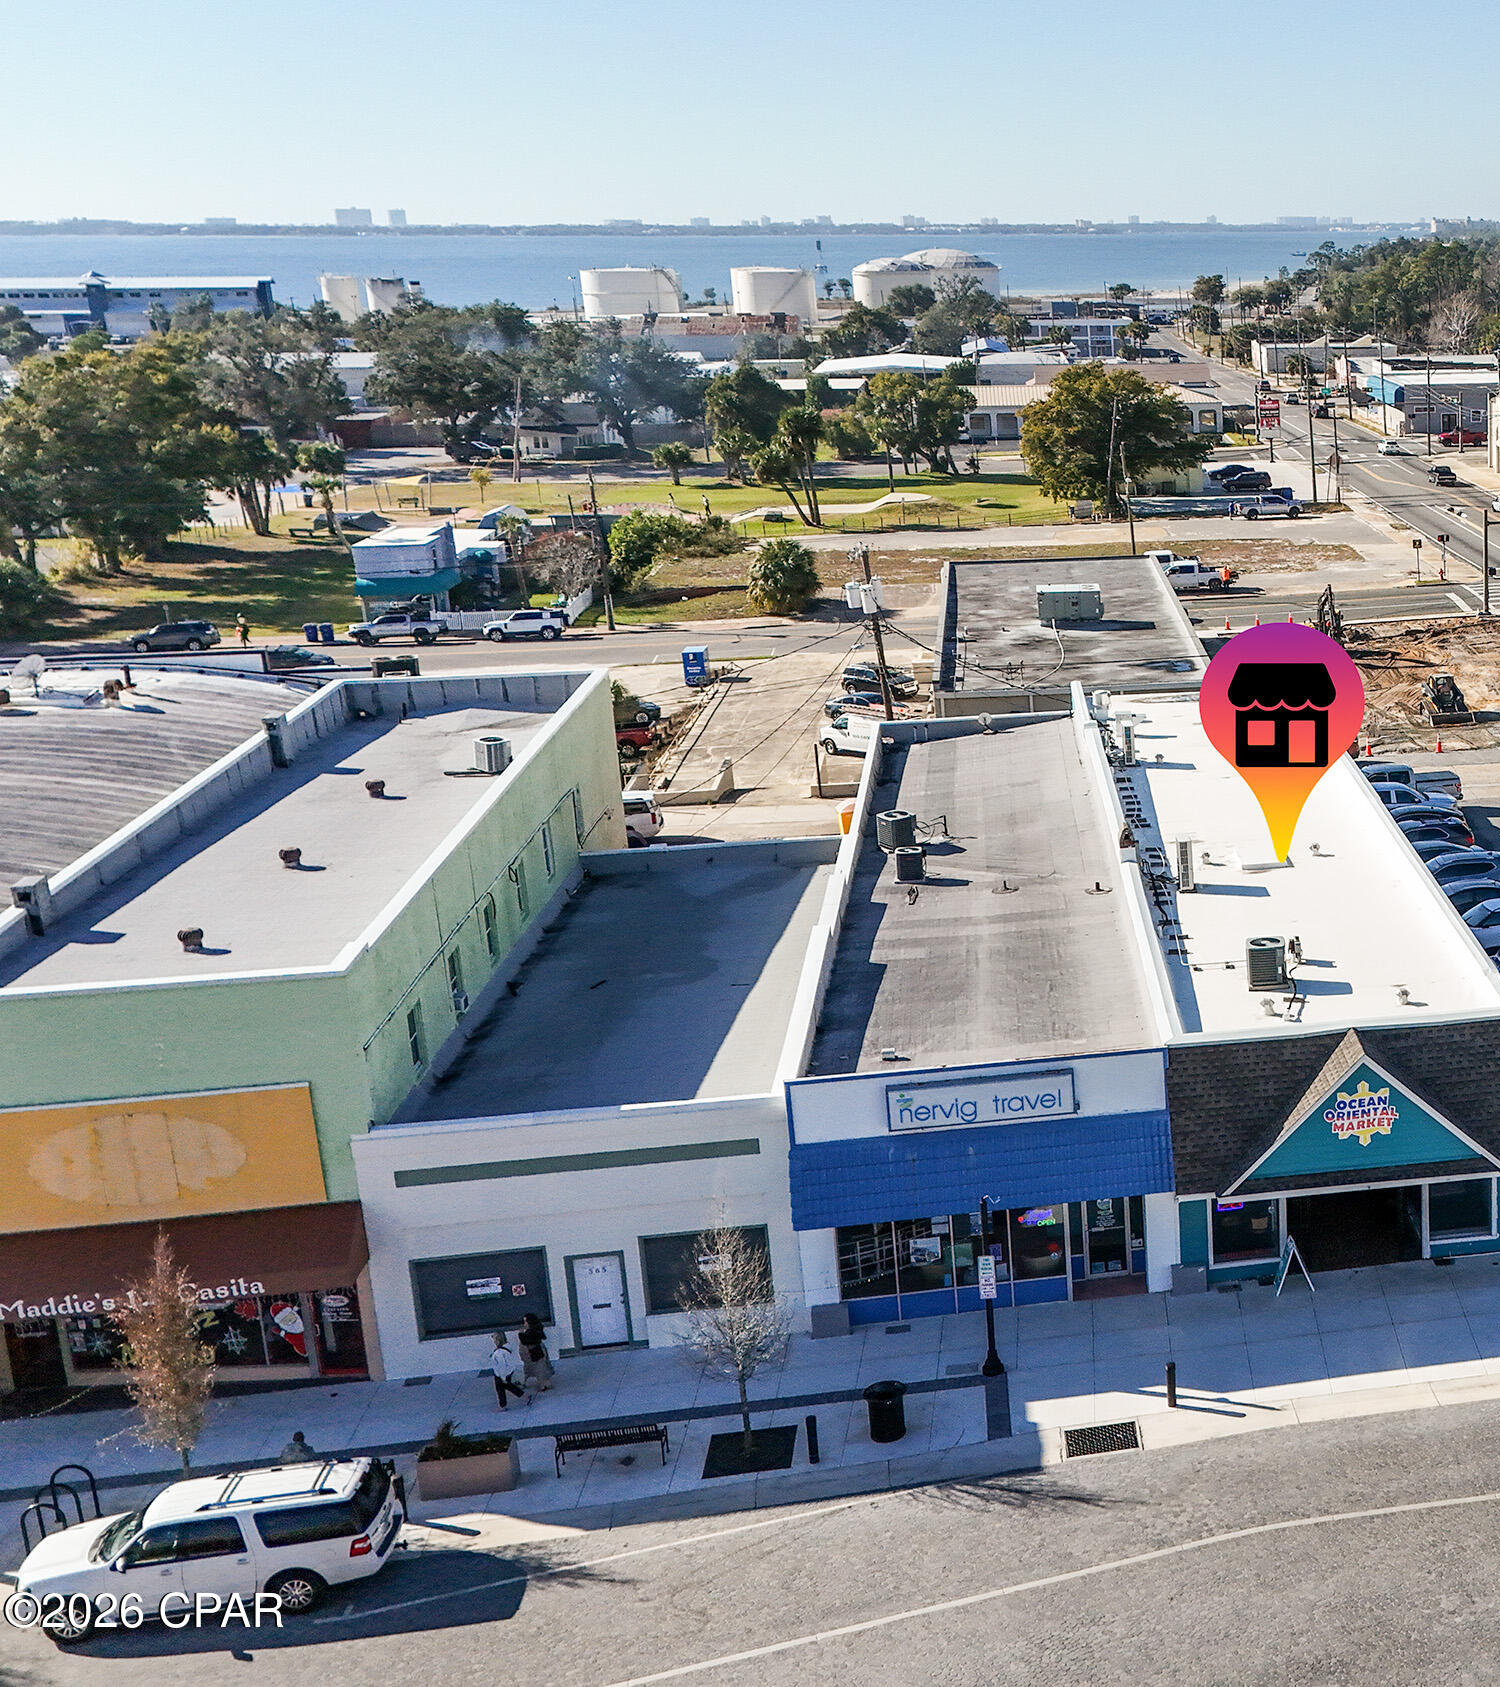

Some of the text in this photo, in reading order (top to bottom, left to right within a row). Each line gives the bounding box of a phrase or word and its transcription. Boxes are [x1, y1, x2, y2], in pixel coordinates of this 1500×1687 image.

[899, 1088, 1062, 1123] nervig travel
[1336, 1095, 1388, 1110] OCEAN
[1324, 1106, 1398, 1122] ORIENTAL
[1333, 1117, 1393, 1132] MARKET
[1037, 1217, 1056, 1227] OPEN
[588, 1266, 607, 1275] 565
[0, 1292, 116, 1320] Maddie's
[178, 1277, 266, 1303] Casita
